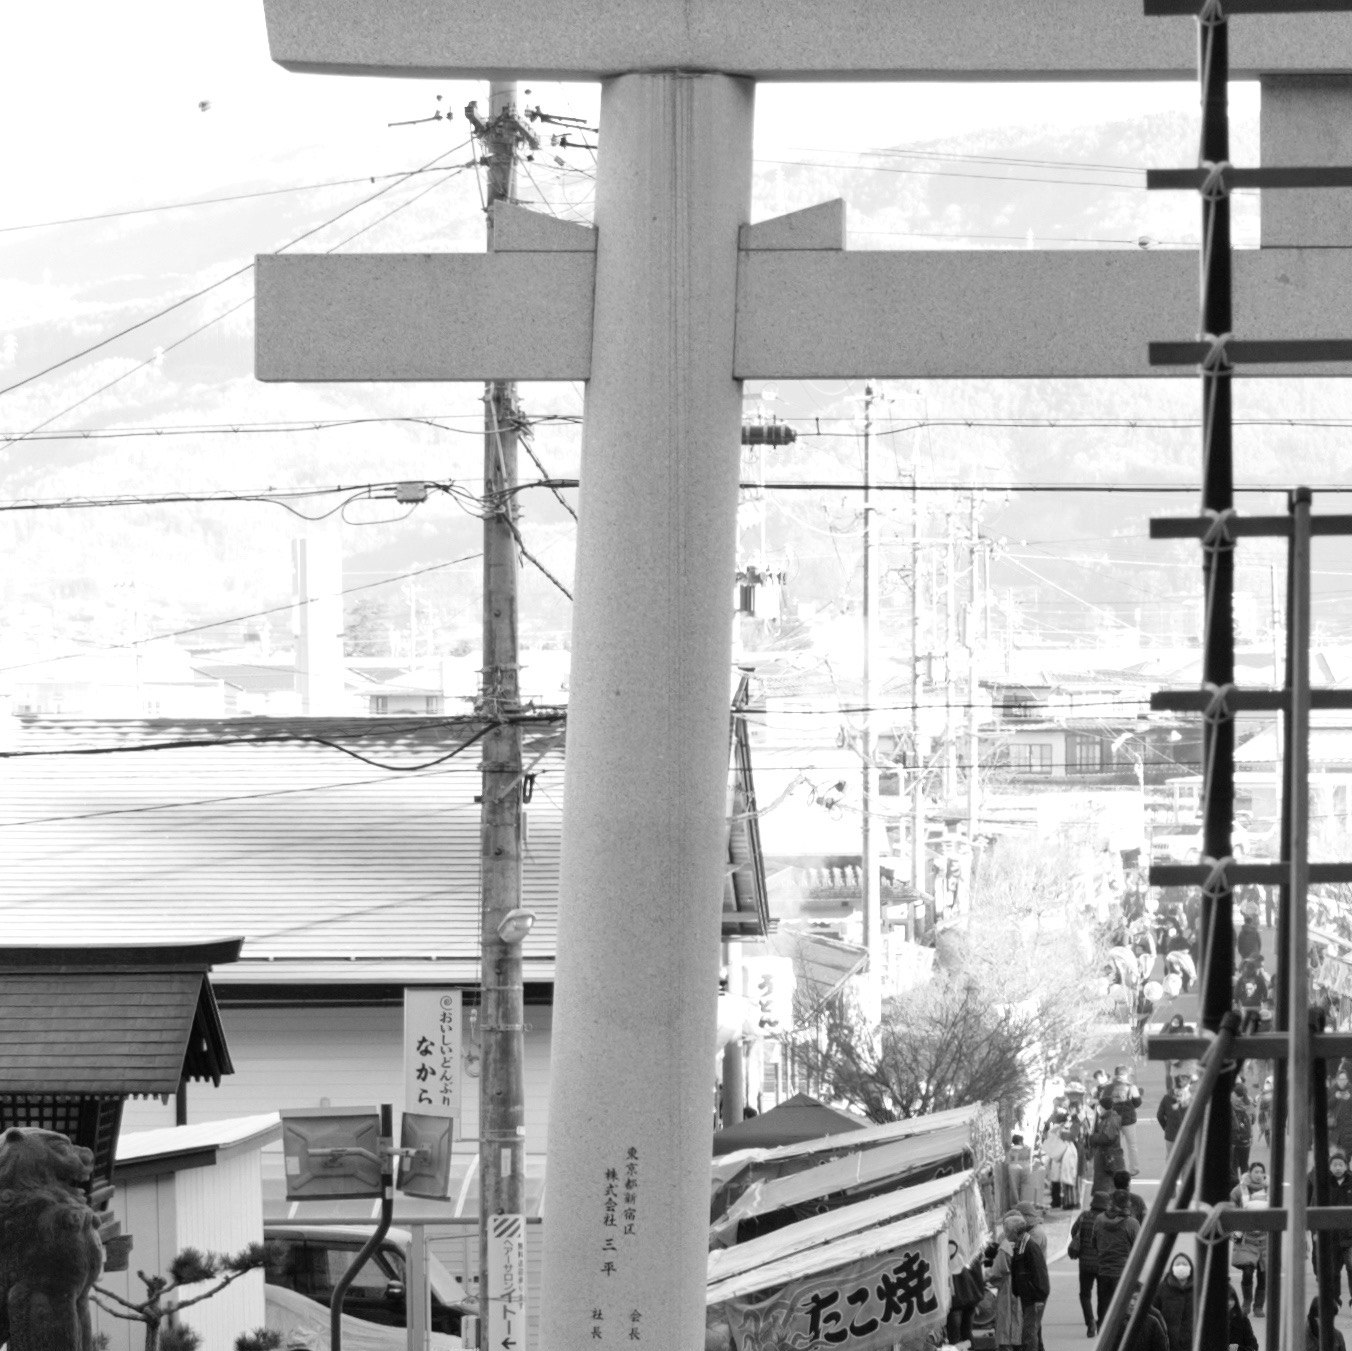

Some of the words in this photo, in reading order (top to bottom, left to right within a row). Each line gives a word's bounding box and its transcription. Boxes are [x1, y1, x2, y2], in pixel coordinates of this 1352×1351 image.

[440, 1011, 453, 1106] おいしいどんぶり
[624, 1146, 639, 1236] 東京都新宿区
[503, 1239, 514, 1290] ヘアーサロン
[500, 1289, 517, 1335] イトー
[802, 1251, 939, 1343] たこ焼
[591, 1307, 604, 1340] 社長
[629, 1308, 642, 1340] 会長
